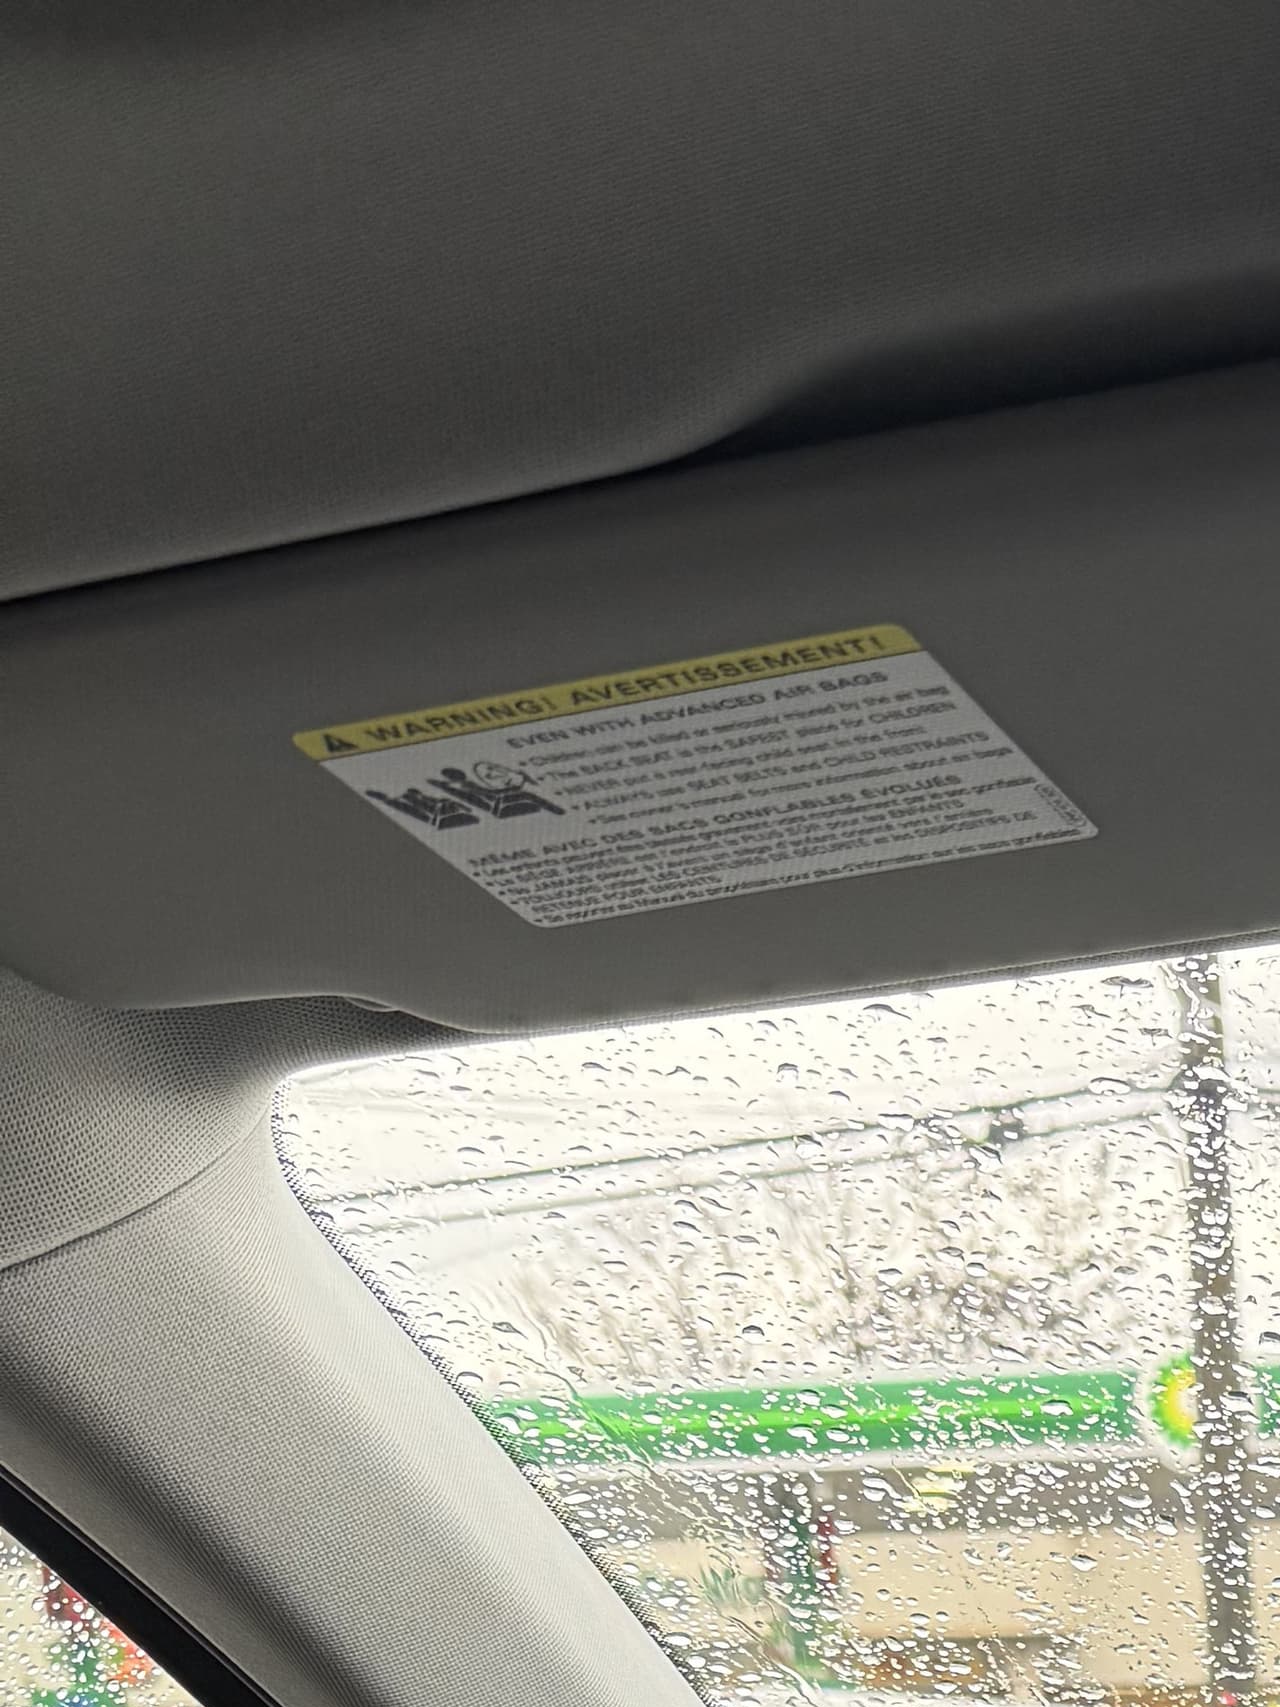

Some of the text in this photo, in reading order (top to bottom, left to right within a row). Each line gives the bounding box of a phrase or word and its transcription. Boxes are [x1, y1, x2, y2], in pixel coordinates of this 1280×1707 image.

[365, 636, 884, 742] WARNING! AVERTISSEMENT!
[506, 672, 889, 748] EVEN WITH ADVANCED AIR BAGS
